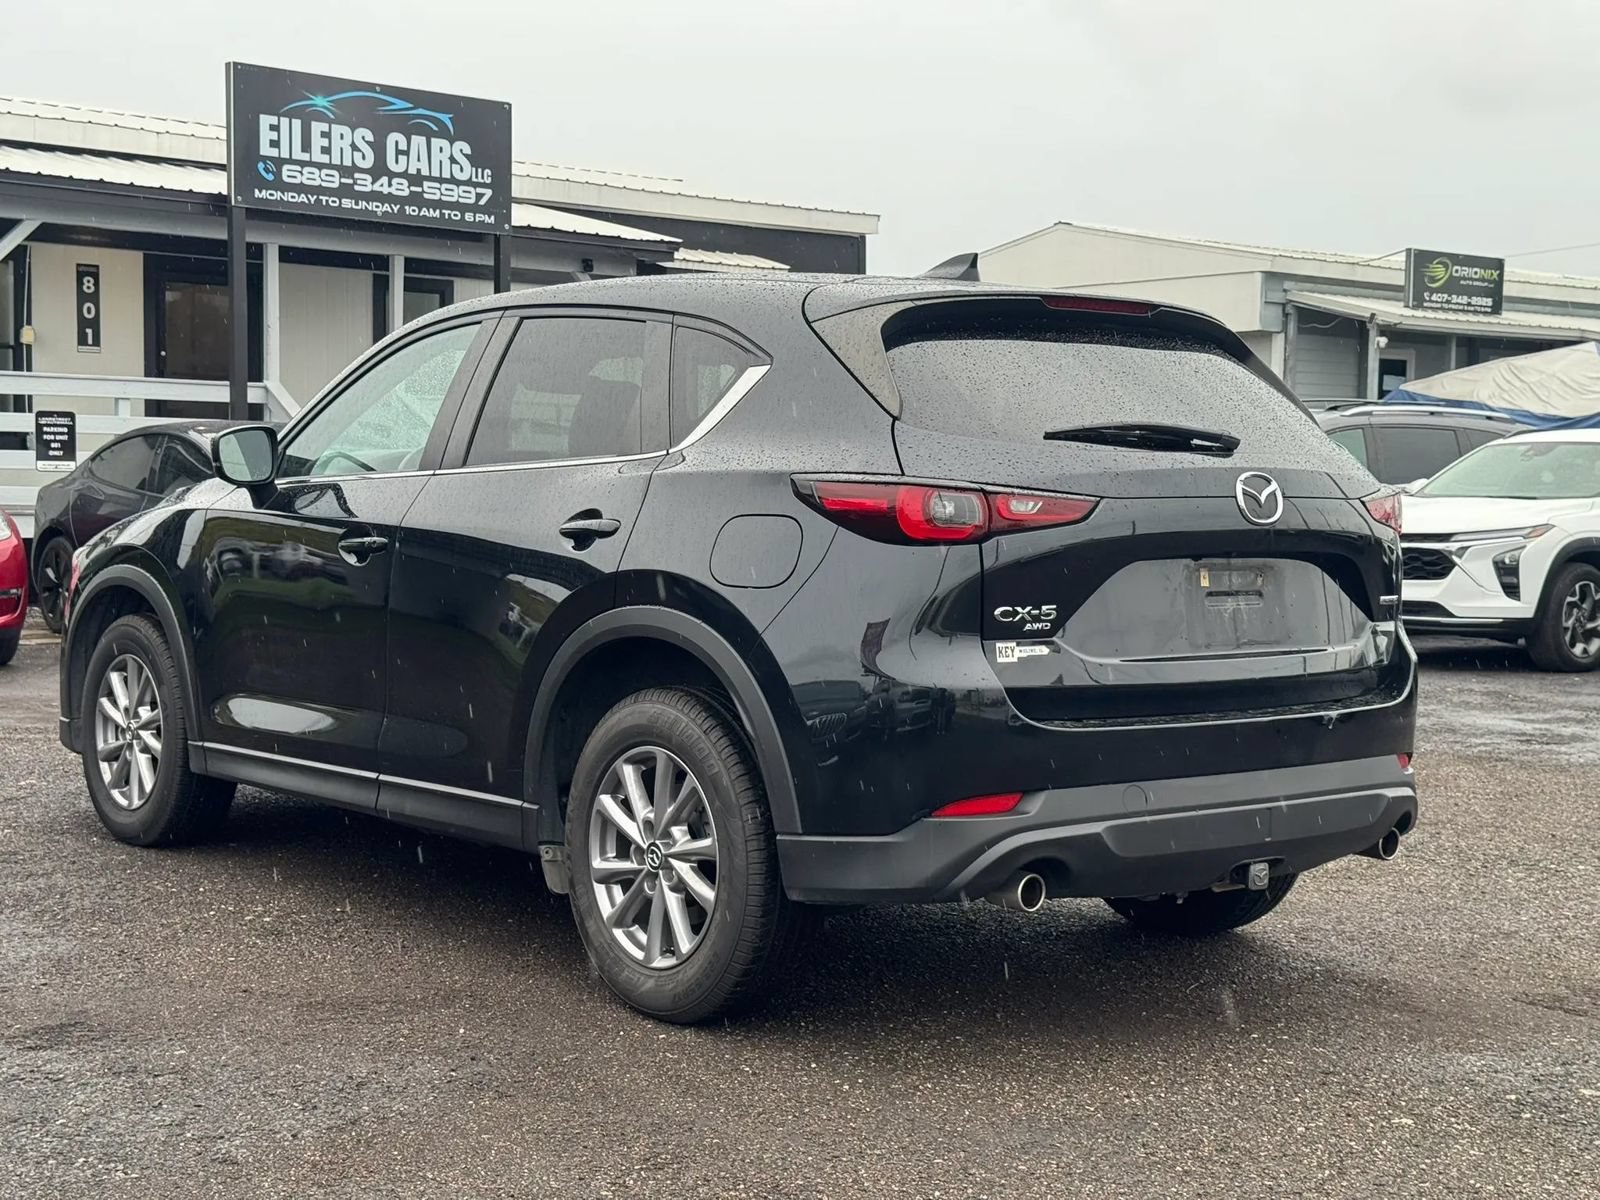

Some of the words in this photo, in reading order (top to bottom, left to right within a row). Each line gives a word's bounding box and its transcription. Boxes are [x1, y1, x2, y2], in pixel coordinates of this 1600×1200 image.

[259, 113, 374, 169] EILERS
[386, 132, 472, 182] CARS
[471, 167, 492, 184] LLC
[281, 164, 493, 206] 689-348-5997
[254, 188, 317, 205] MONDAY
[319, 195, 339, 207] TO
[341, 198, 400, 214] SUNDAY
[404, 205, 419, 216] 10
[419, 207, 440, 218] AM
[441, 209, 461, 220] TO
[464, 212, 474, 222] 6
[475, 213, 495, 224] PM
[1452, 265, 1500, 280] ORIONIX
[82, 276, 96, 345] 801
[994, 604, 1057, 622] CX-5
[1023, 622, 1051, 632] AWD
[997, 646, 1016, 659] KEY
